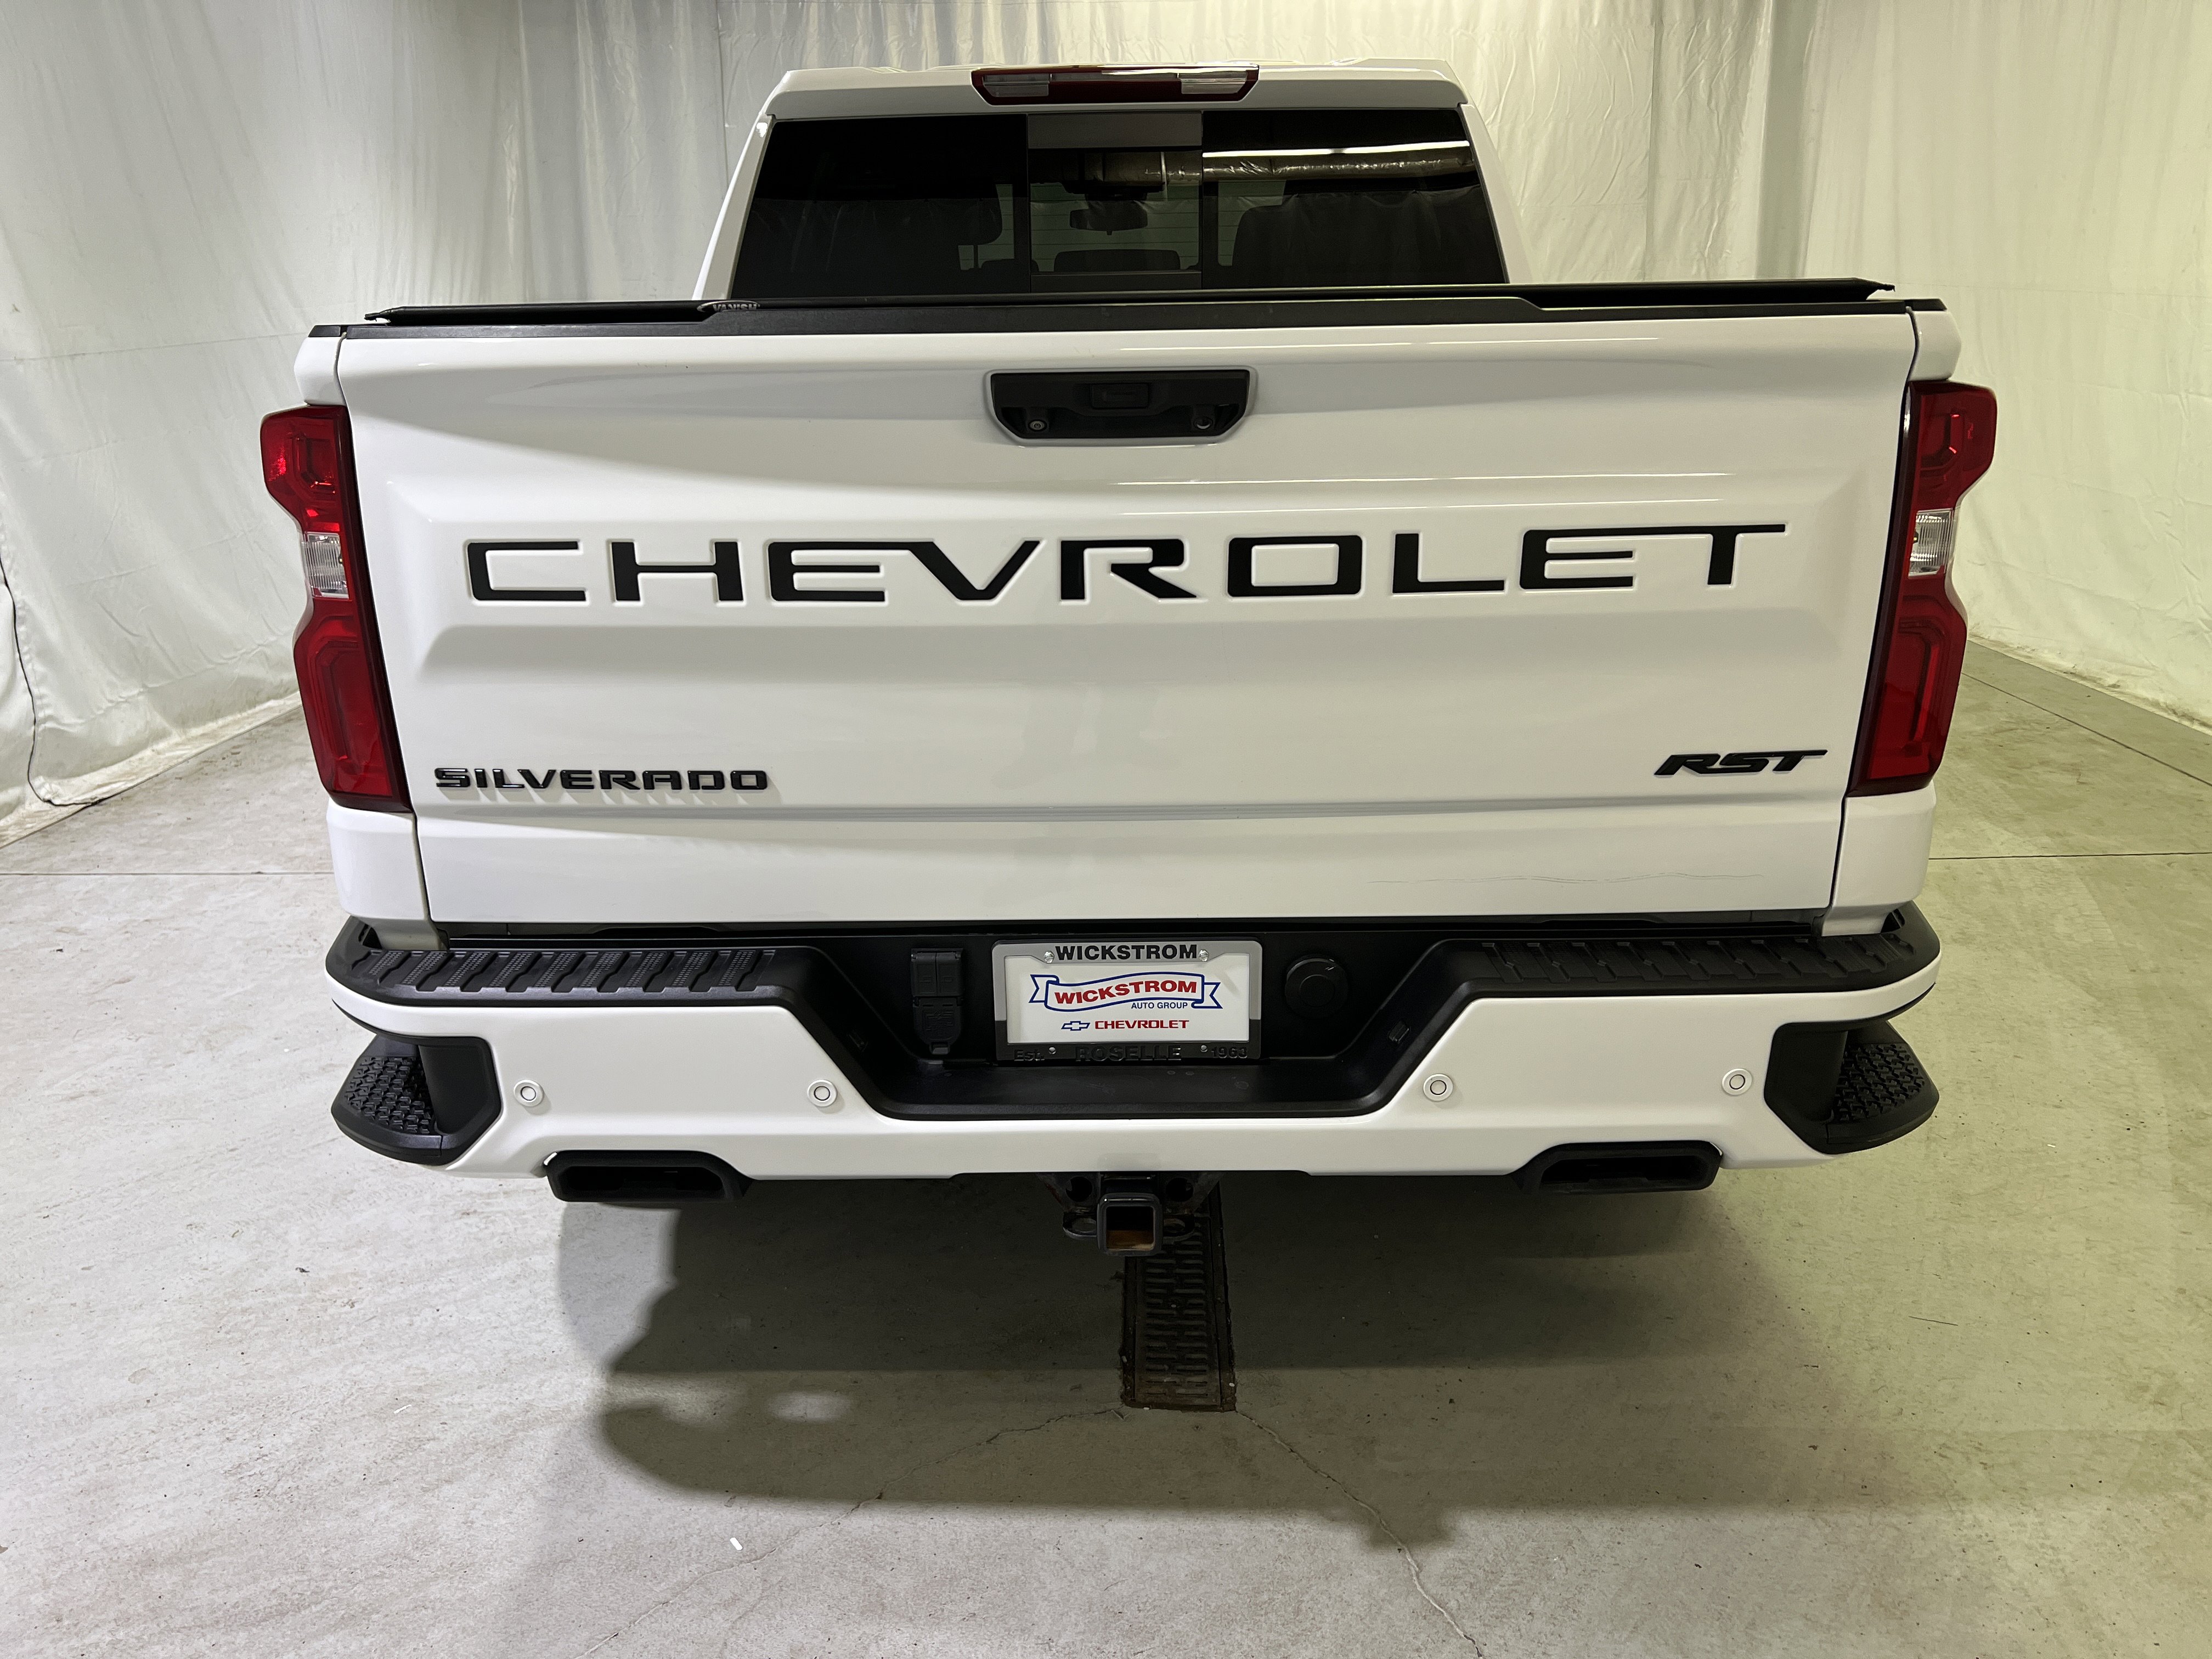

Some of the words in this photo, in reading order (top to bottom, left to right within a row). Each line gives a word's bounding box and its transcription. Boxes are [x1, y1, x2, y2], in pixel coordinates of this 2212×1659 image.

[467, 523, 1786, 602] CHEVROLET
[1654, 749, 1828, 776] RST
[434, 768, 768, 791] SILVERADO
[1055, 944, 1197, 961] WICKSTROM
[1054, 980, 1197, 1005] WICKSTROM
[1094, 1020, 1189, 1030] CHEVROLET
[1014, 1048, 1045, 1062] Est.
[1075, 1045, 1182, 1062] ROSELLE
[1211, 1046, 1248, 1059] 1963
